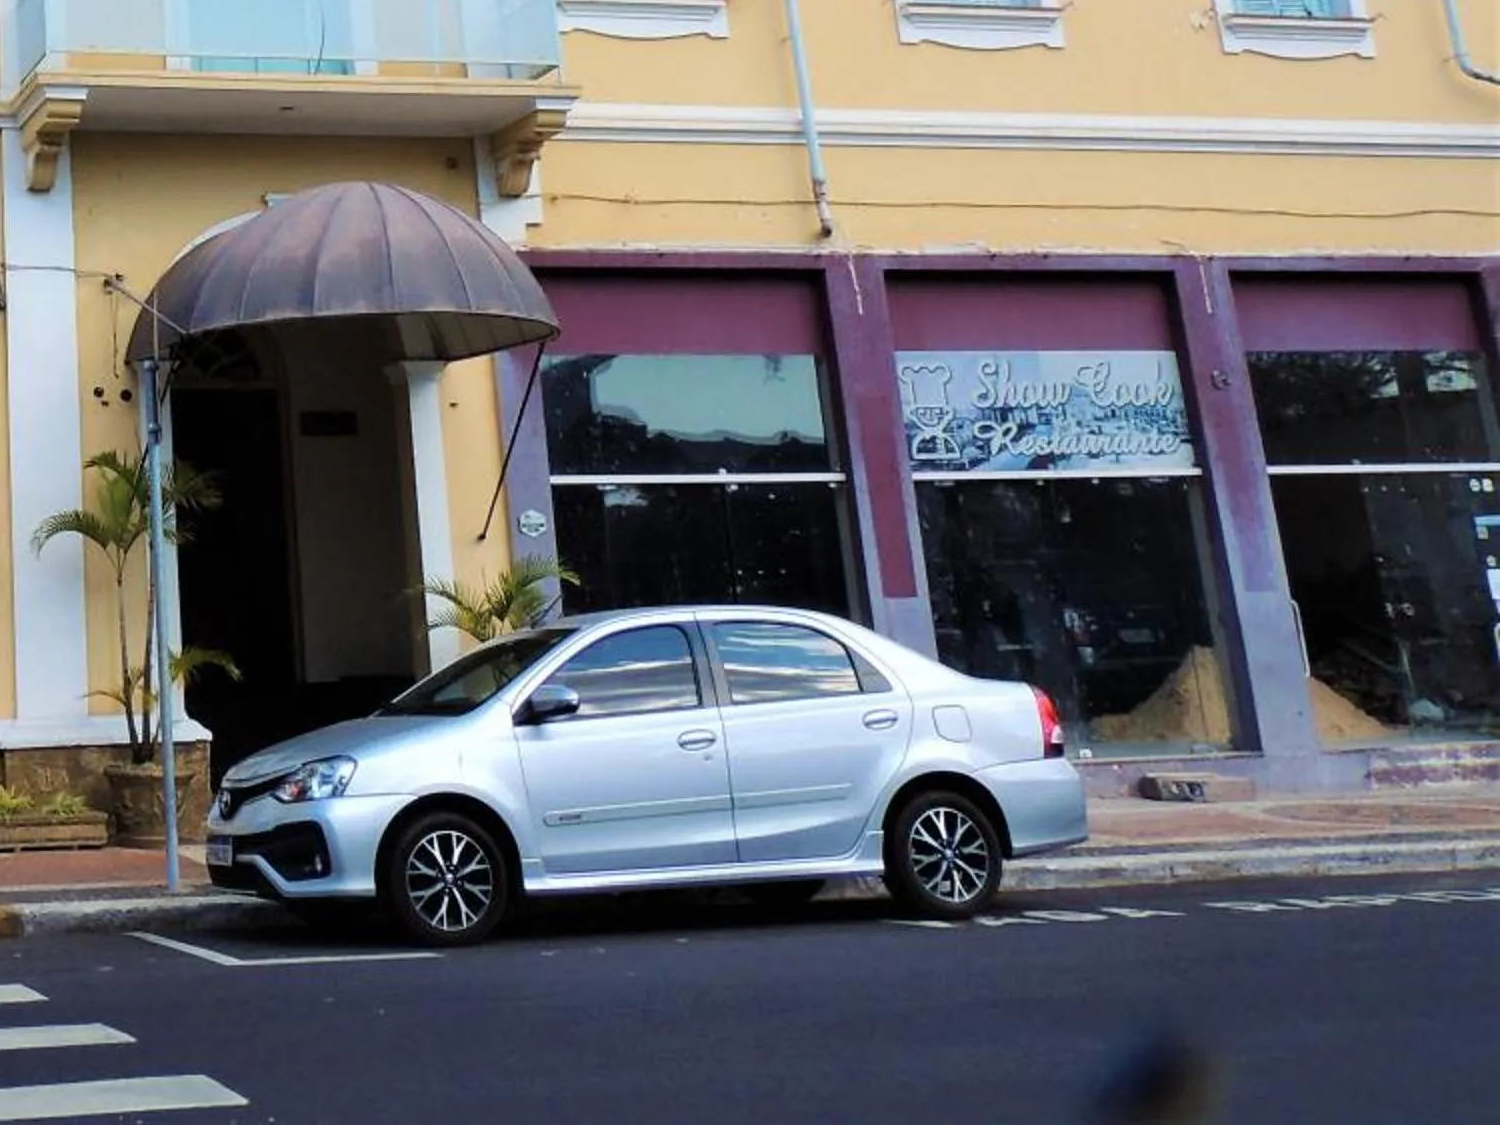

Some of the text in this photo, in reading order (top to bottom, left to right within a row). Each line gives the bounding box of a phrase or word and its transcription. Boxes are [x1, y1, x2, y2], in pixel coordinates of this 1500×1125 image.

[973, 359, 1174, 409] Show Cook
[974, 420, 1182, 457] Restaurante
